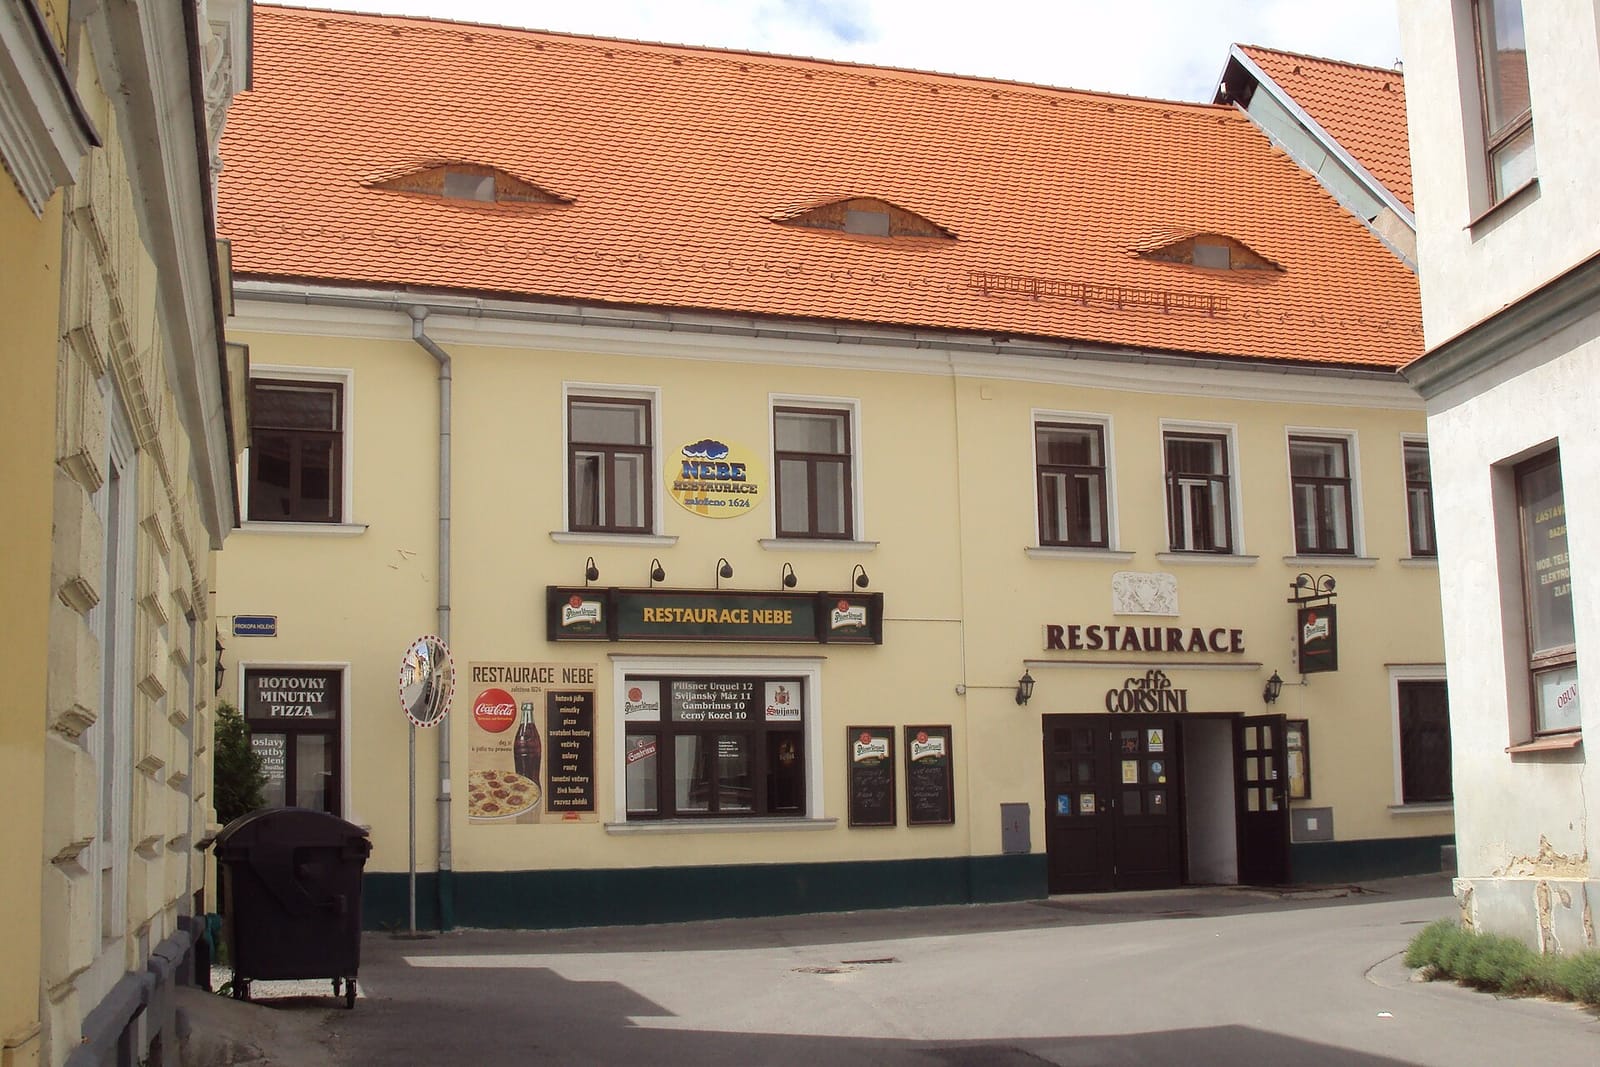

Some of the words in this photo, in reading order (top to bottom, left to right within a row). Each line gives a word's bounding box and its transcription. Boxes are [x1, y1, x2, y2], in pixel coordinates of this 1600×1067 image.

[681, 460, 746, 481] NEBE
[673, 480, 758, 494] RESTAURACE
[728, 498, 751, 508] 1624
[643, 607, 749, 624] RESTAURACE
[752, 609, 793, 625] NEBE
[1047, 624, 1245, 653] RESTAURACE
[473, 666, 554, 684] RESTAURACE
[562, 668, 594, 684] NEBE
[258, 677, 327, 689] HOTOVKY
[710, 682, 739, 692] Urquel
[743, 682, 753, 690] 12
[260, 691, 325, 703] MINUTKY
[674, 691, 717, 702] Svijanský
[720, 691, 738, 700] Máz
[741, 692, 751, 700] 11
[1105, 688, 1188, 713] CORSINI
[1557, 683, 1577, 708] OBUV
[271, 705, 314, 717] PIZZA
[475, 703, 514, 716] Coca-Cola
[682, 701, 731, 710] Gambrinus
[734, 702, 745, 710] 10
[766, 705, 799, 716] Svijany
[681, 711, 706, 721] černý
[708, 711, 733, 720] Kozel
[736, 711, 747, 720] 10
[252, 738, 285, 749] oslavy
[256, 747, 285, 758] vatby
